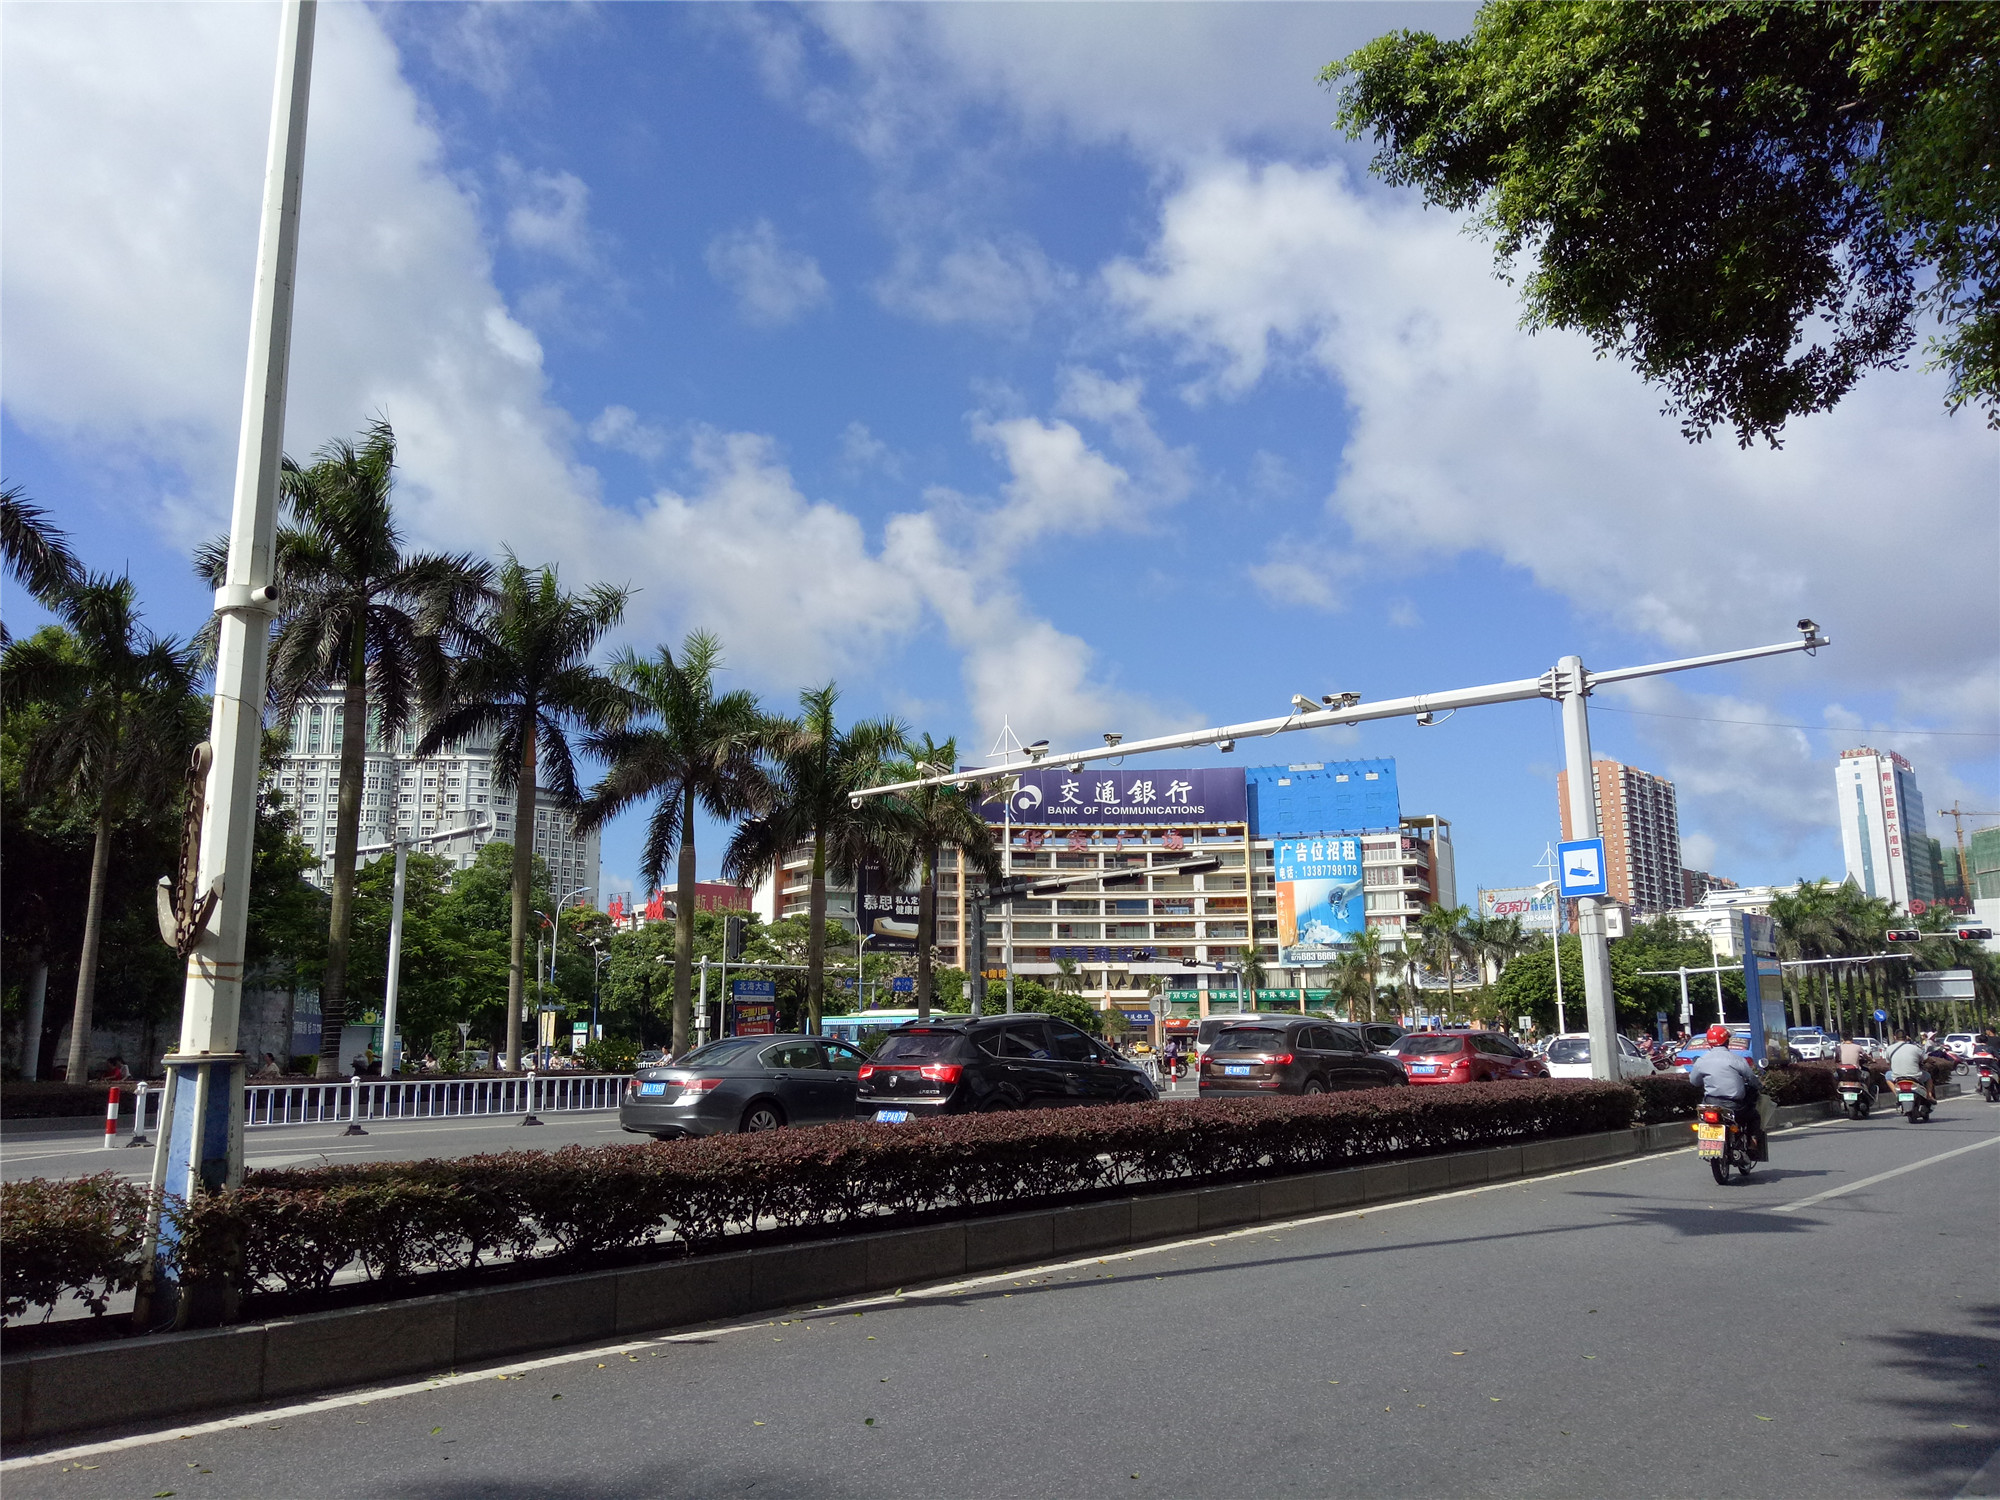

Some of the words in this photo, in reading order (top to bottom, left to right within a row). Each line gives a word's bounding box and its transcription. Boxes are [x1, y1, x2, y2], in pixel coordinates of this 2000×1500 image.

[1047, 806, 1078, 815] BANK
[1083, 806, 1099, 815] OF
[1104, 805, 1205, 815] COMMUNICATIONS
[1279, 840, 1357, 864] 广告位招租
[863, 895, 893, 911] 慕思
[895, 896, 920, 905] 私人定
[739, 982, 770, 992] 北海大道
